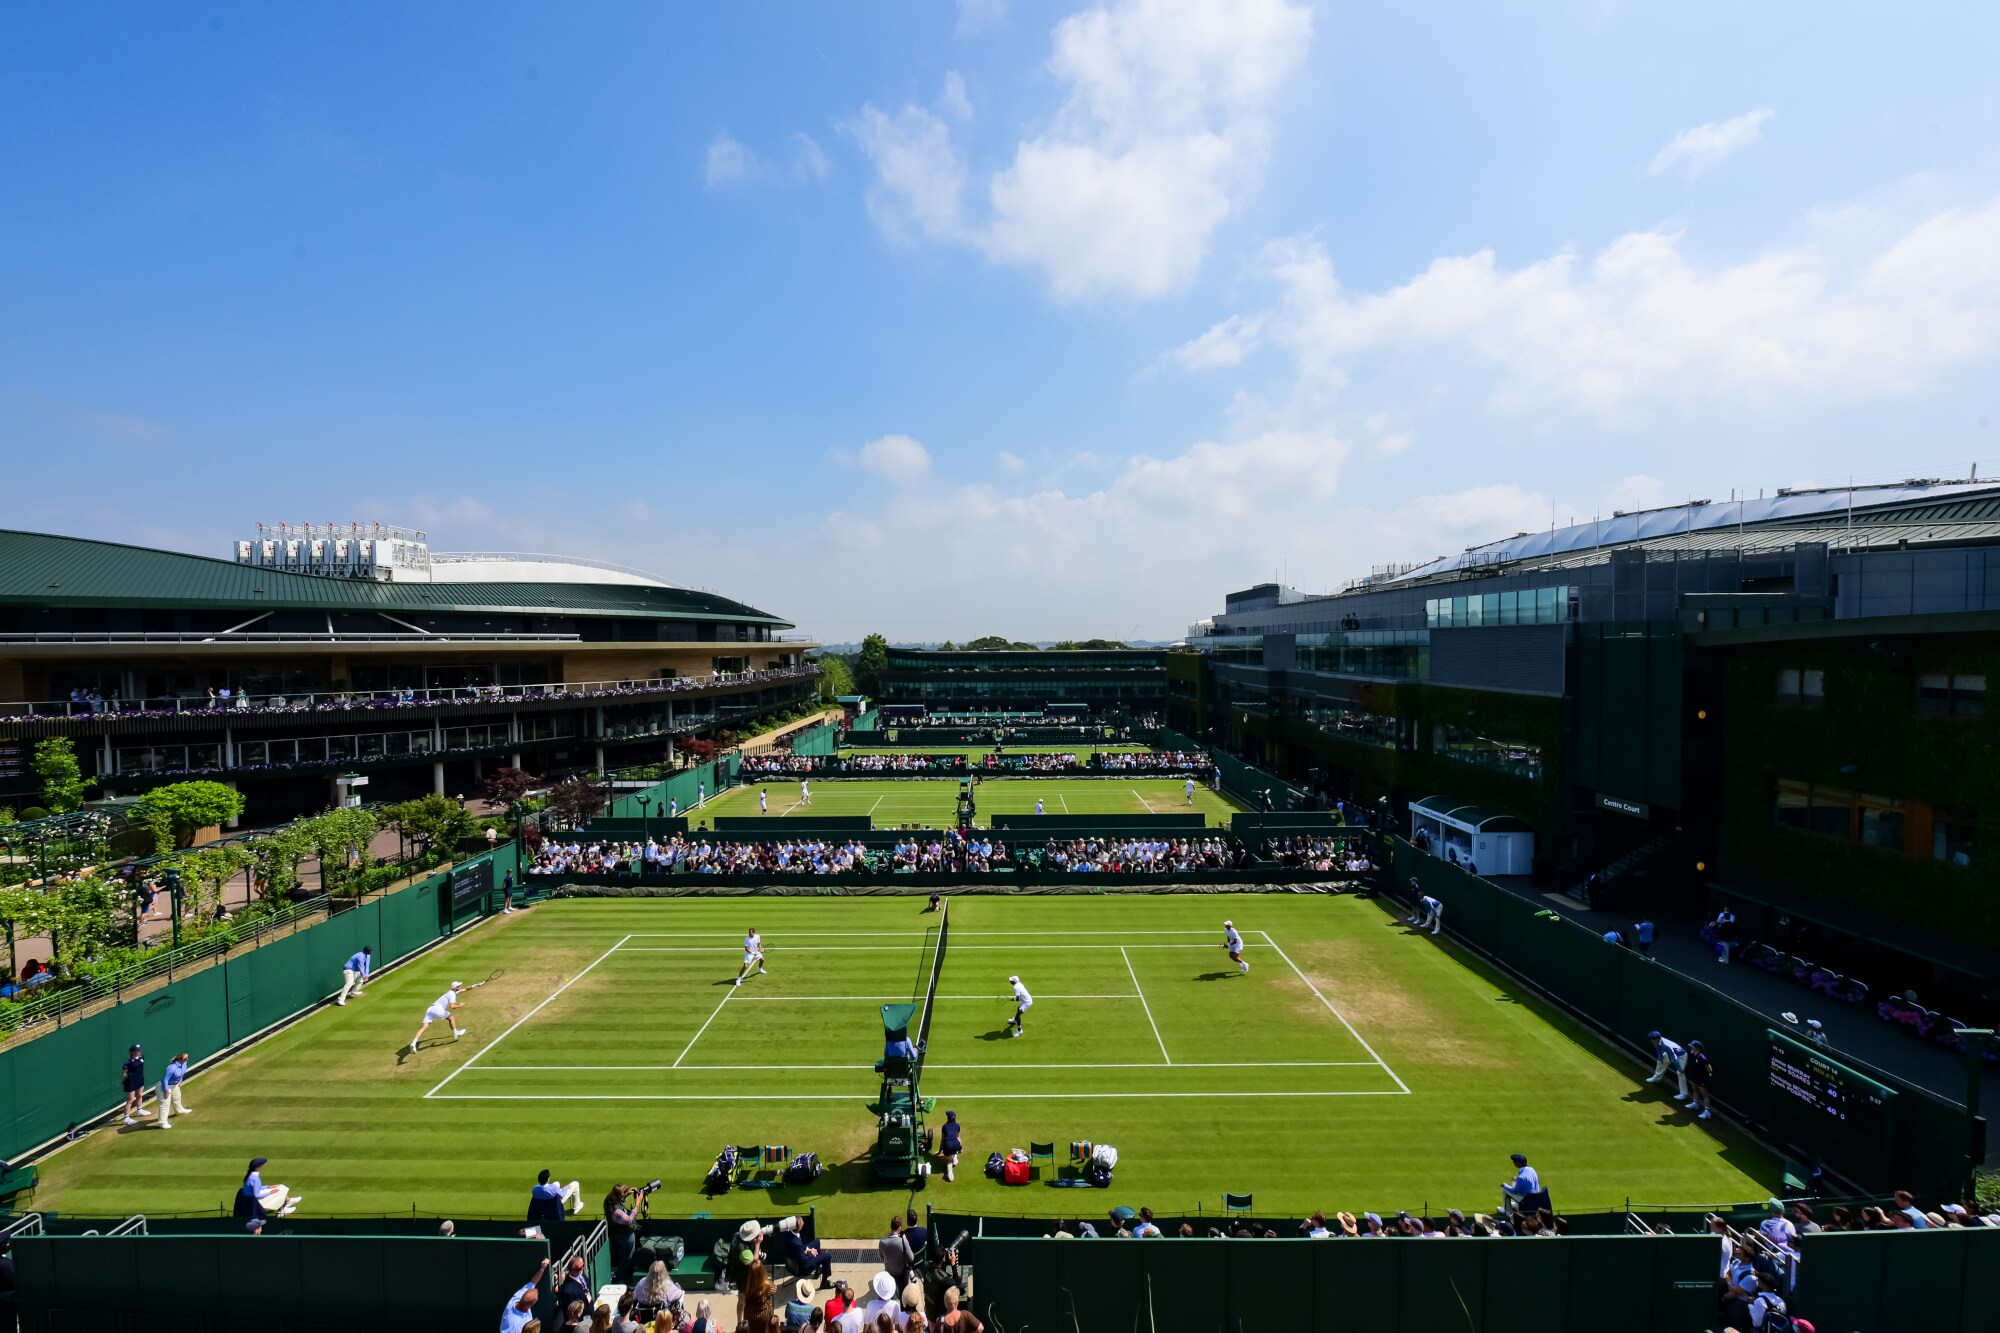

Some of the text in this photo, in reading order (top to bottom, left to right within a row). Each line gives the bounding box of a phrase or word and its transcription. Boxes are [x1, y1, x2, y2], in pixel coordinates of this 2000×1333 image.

[1604, 799, 1640, 813] Centre Court
[1810, 1058, 1838, 1076] COURT 14
[1813, 1066, 1835, 1081] ROLEX
[1828, 1088, 1837, 1098] 40
[1827, 1106, 1837, 1115] 40
